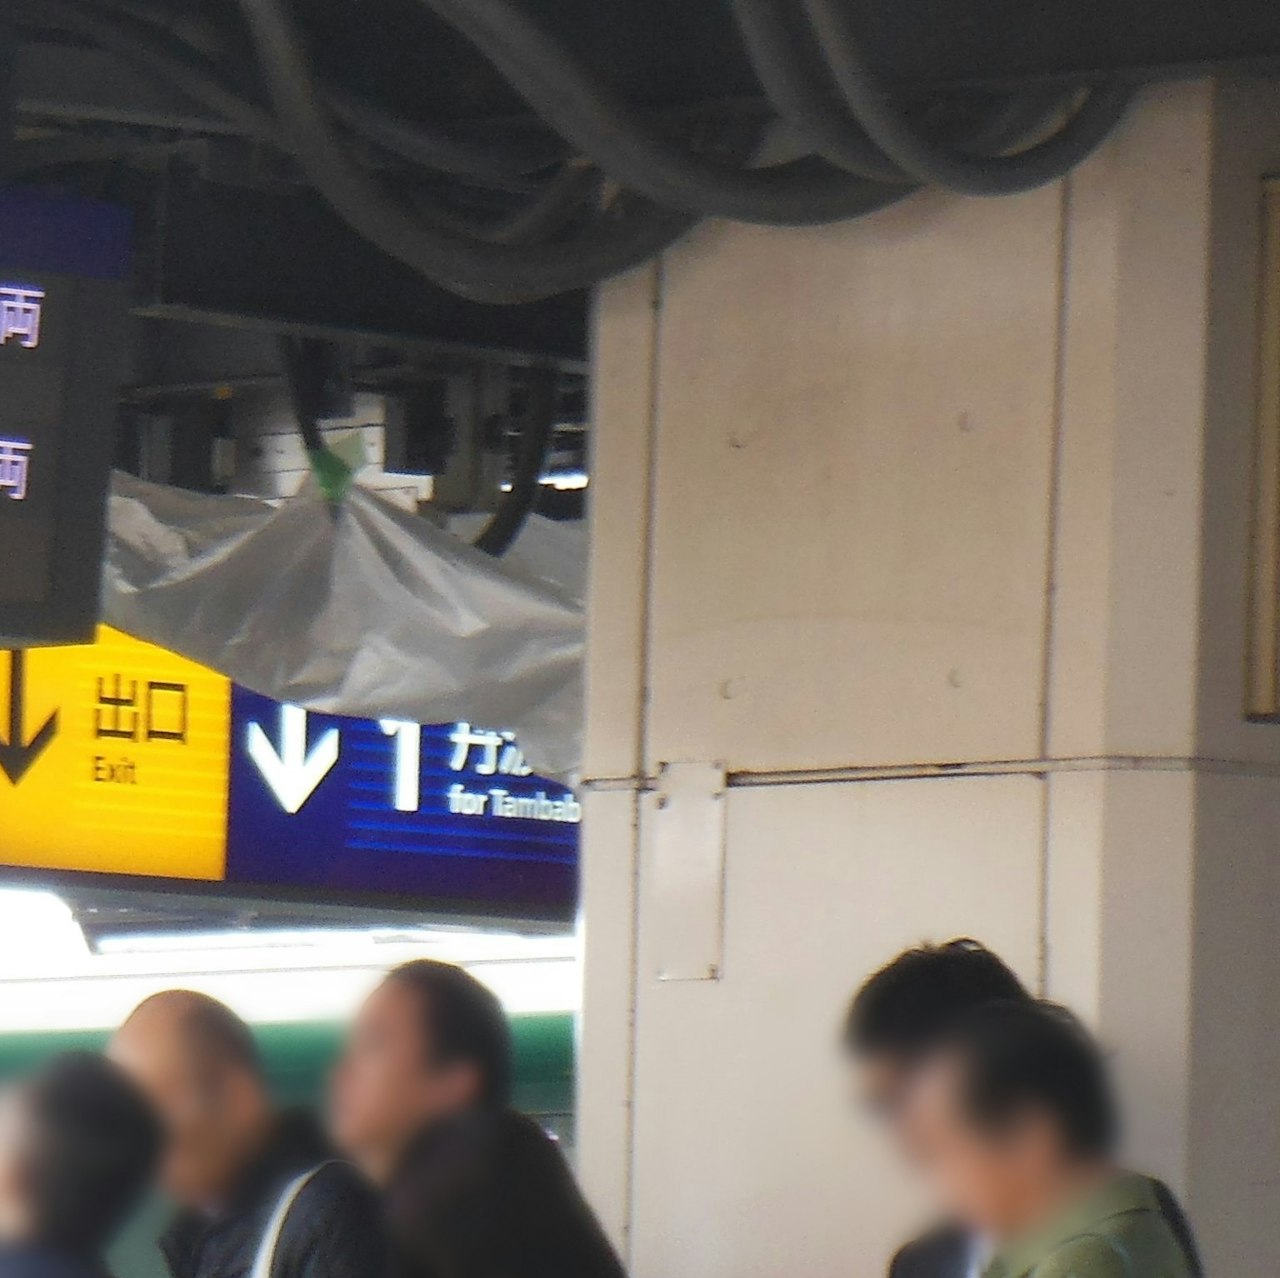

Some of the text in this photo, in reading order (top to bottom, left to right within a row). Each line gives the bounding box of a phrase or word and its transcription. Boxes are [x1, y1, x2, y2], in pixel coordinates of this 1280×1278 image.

[94, 672, 189, 746] 出口
[92, 756, 137, 786] Exit
[379, 717, 421, 812] 1
[447, 783, 488, 816] for
